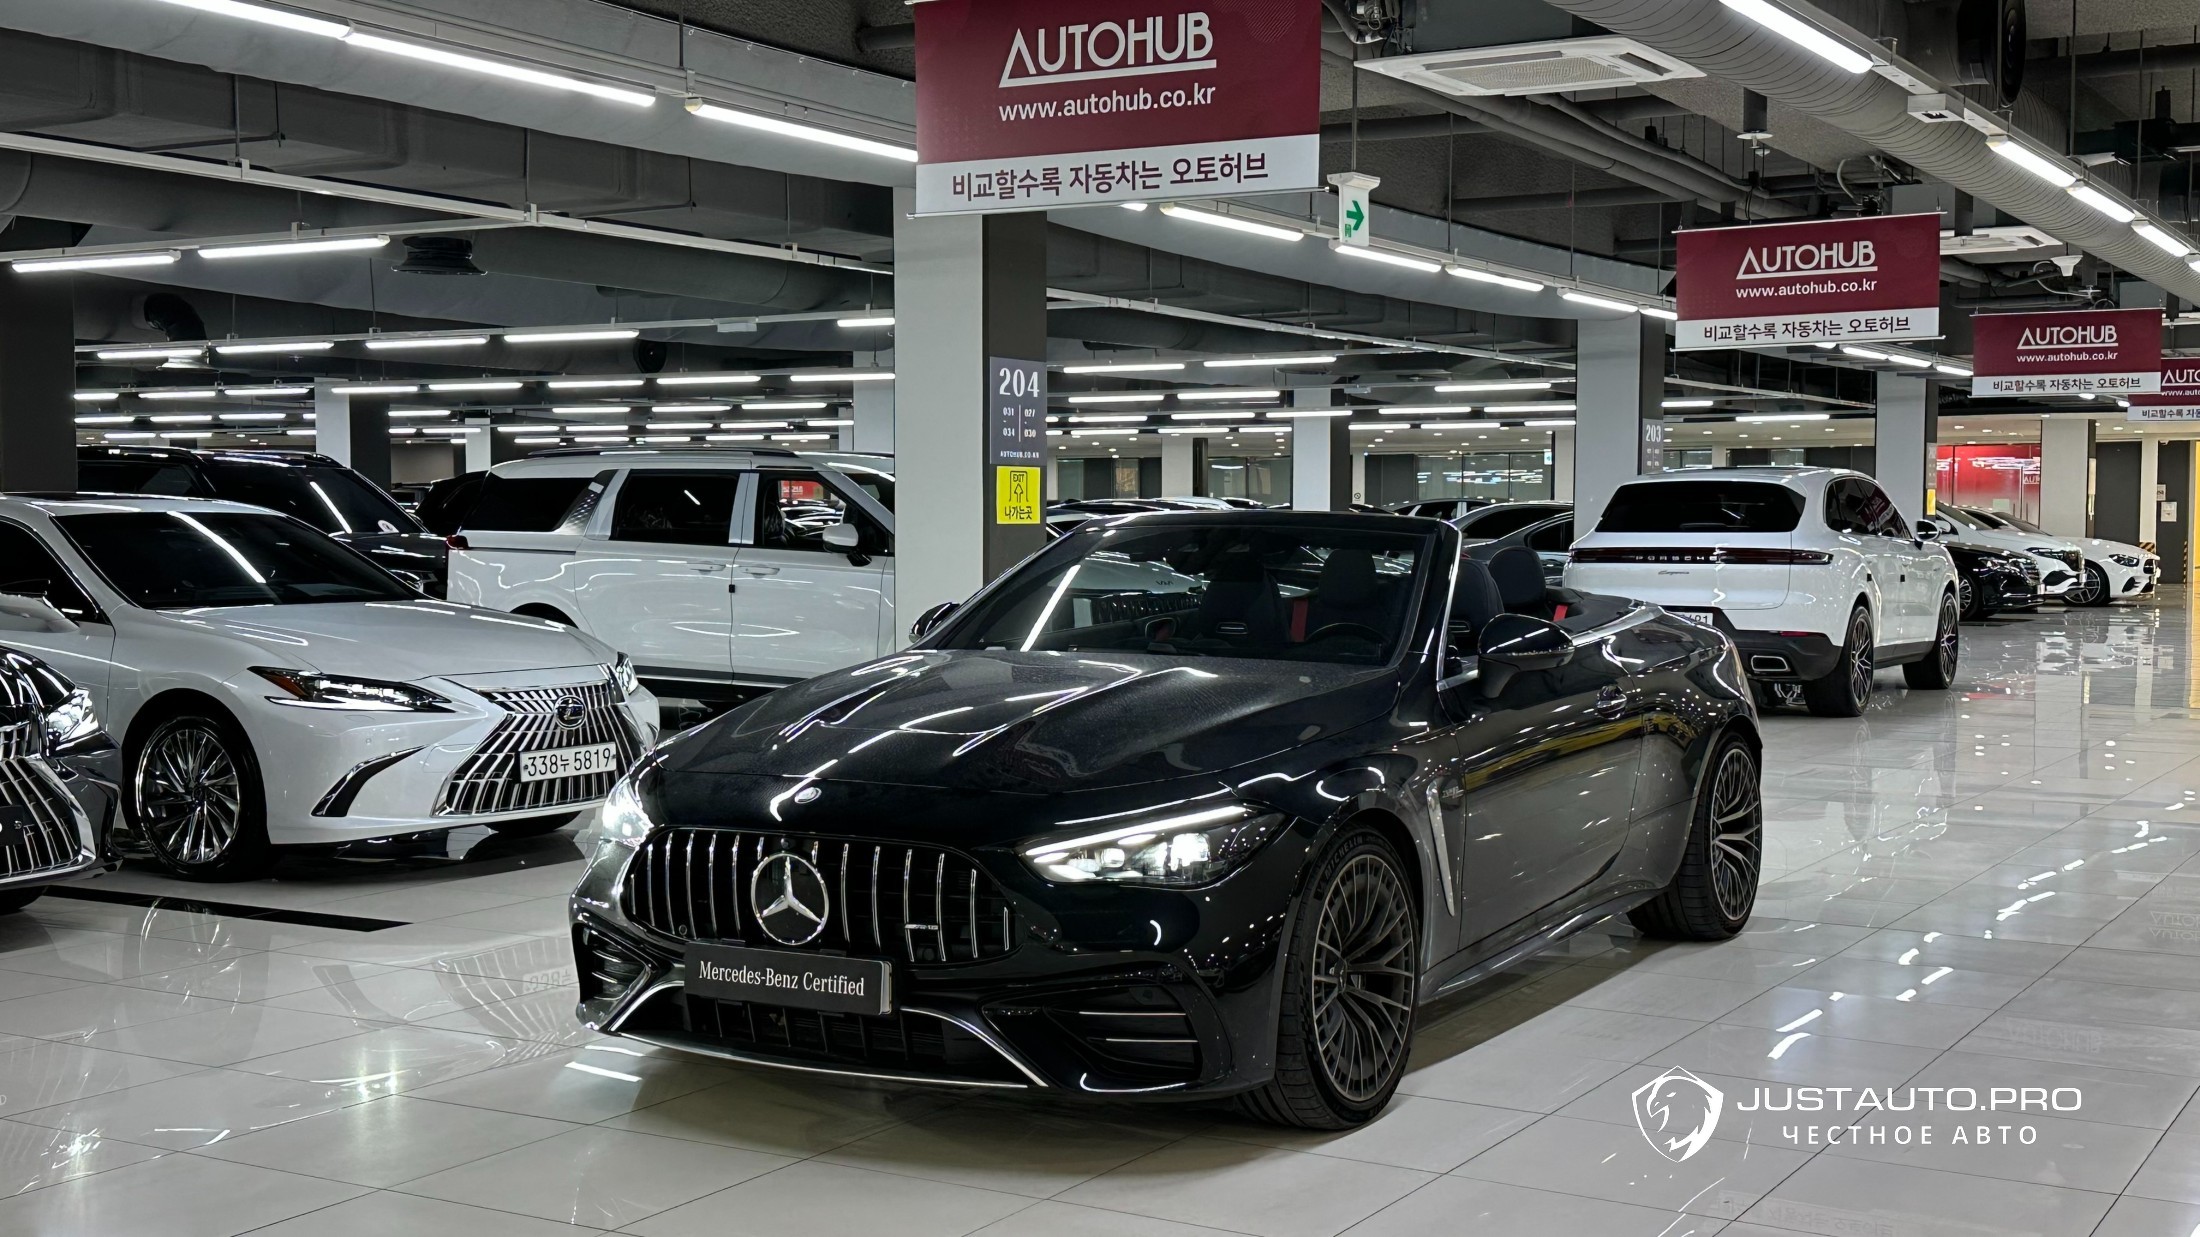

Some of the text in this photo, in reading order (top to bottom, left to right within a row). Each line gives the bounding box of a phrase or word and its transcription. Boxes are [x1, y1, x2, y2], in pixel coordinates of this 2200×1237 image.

[998, 11, 1217, 88] AUTOHUB
[998, 82, 1216, 122] www.autohub.co.kr
[952, 152, 1269, 202] 비교할수록 자동차는 오토허브
[1736, 240, 1878, 280] AUTOHUB
[1736, 278, 1877, 298] www.autohub.co.kr
[1704, 316, 1911, 341] 비교할수록 자동차는 오토허브
[2017, 325, 2119, 350] AUTOHUB
[2017, 351, 2118, 363] www.autohub.co.kr
[999, 367, 1040, 398] 204
[1993, 377, 2141, 392] 비교할수록 자동차는 오토허브
[1003, 407, 1014, 417] 031
[1645, 424, 1662, 443] 203
[1013, 473, 1025, 482] EXIT
[1004, 505, 1033, 520] 나가는곳
[527, 747, 611, 777] 338누 5819
[1324, 835, 1363, 880] MICHELIN
[699, 960, 865, 996] Mercedes-Benz Certified
